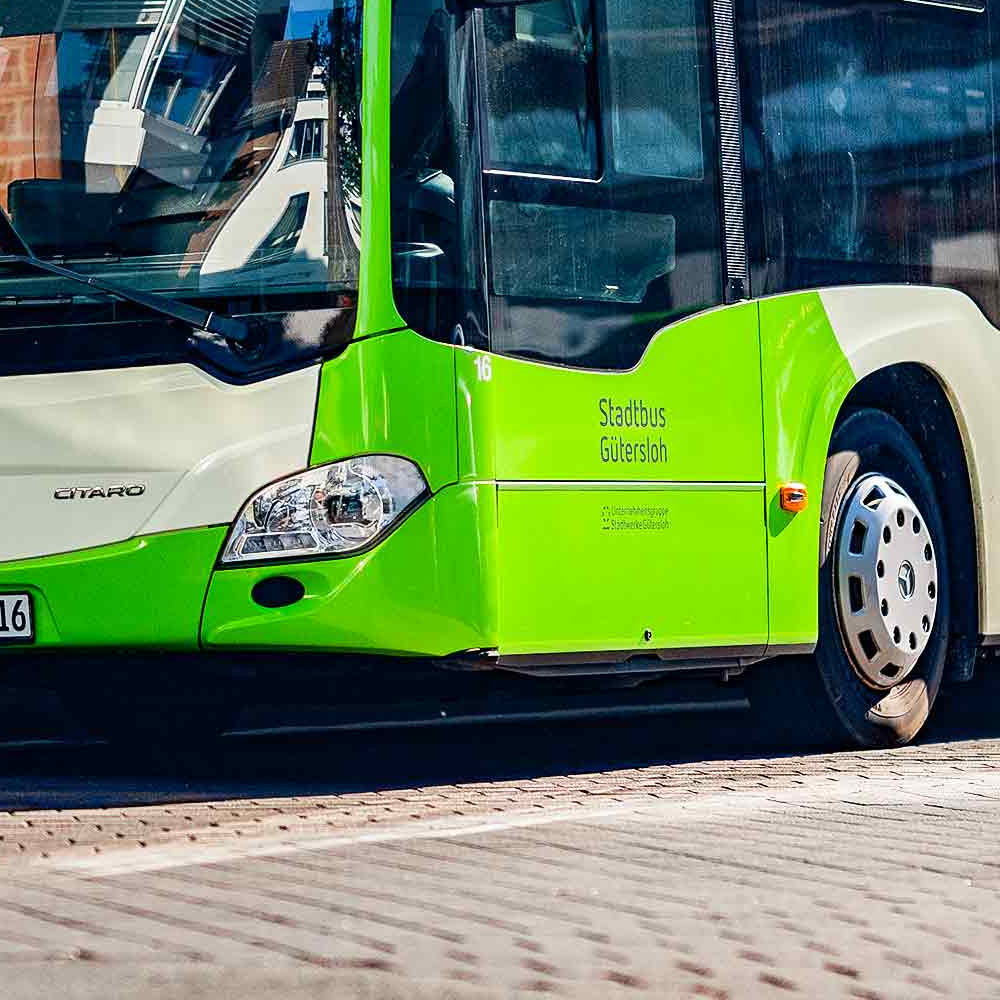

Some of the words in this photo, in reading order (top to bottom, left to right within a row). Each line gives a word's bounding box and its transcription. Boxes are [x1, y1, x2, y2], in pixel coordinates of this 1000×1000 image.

[474, 355, 492, 381] 16
[599, 398, 666, 428] Stadtbus
[600, 436, 668, 463] Gütersloh
[54, 484, 146, 500] CITARO
